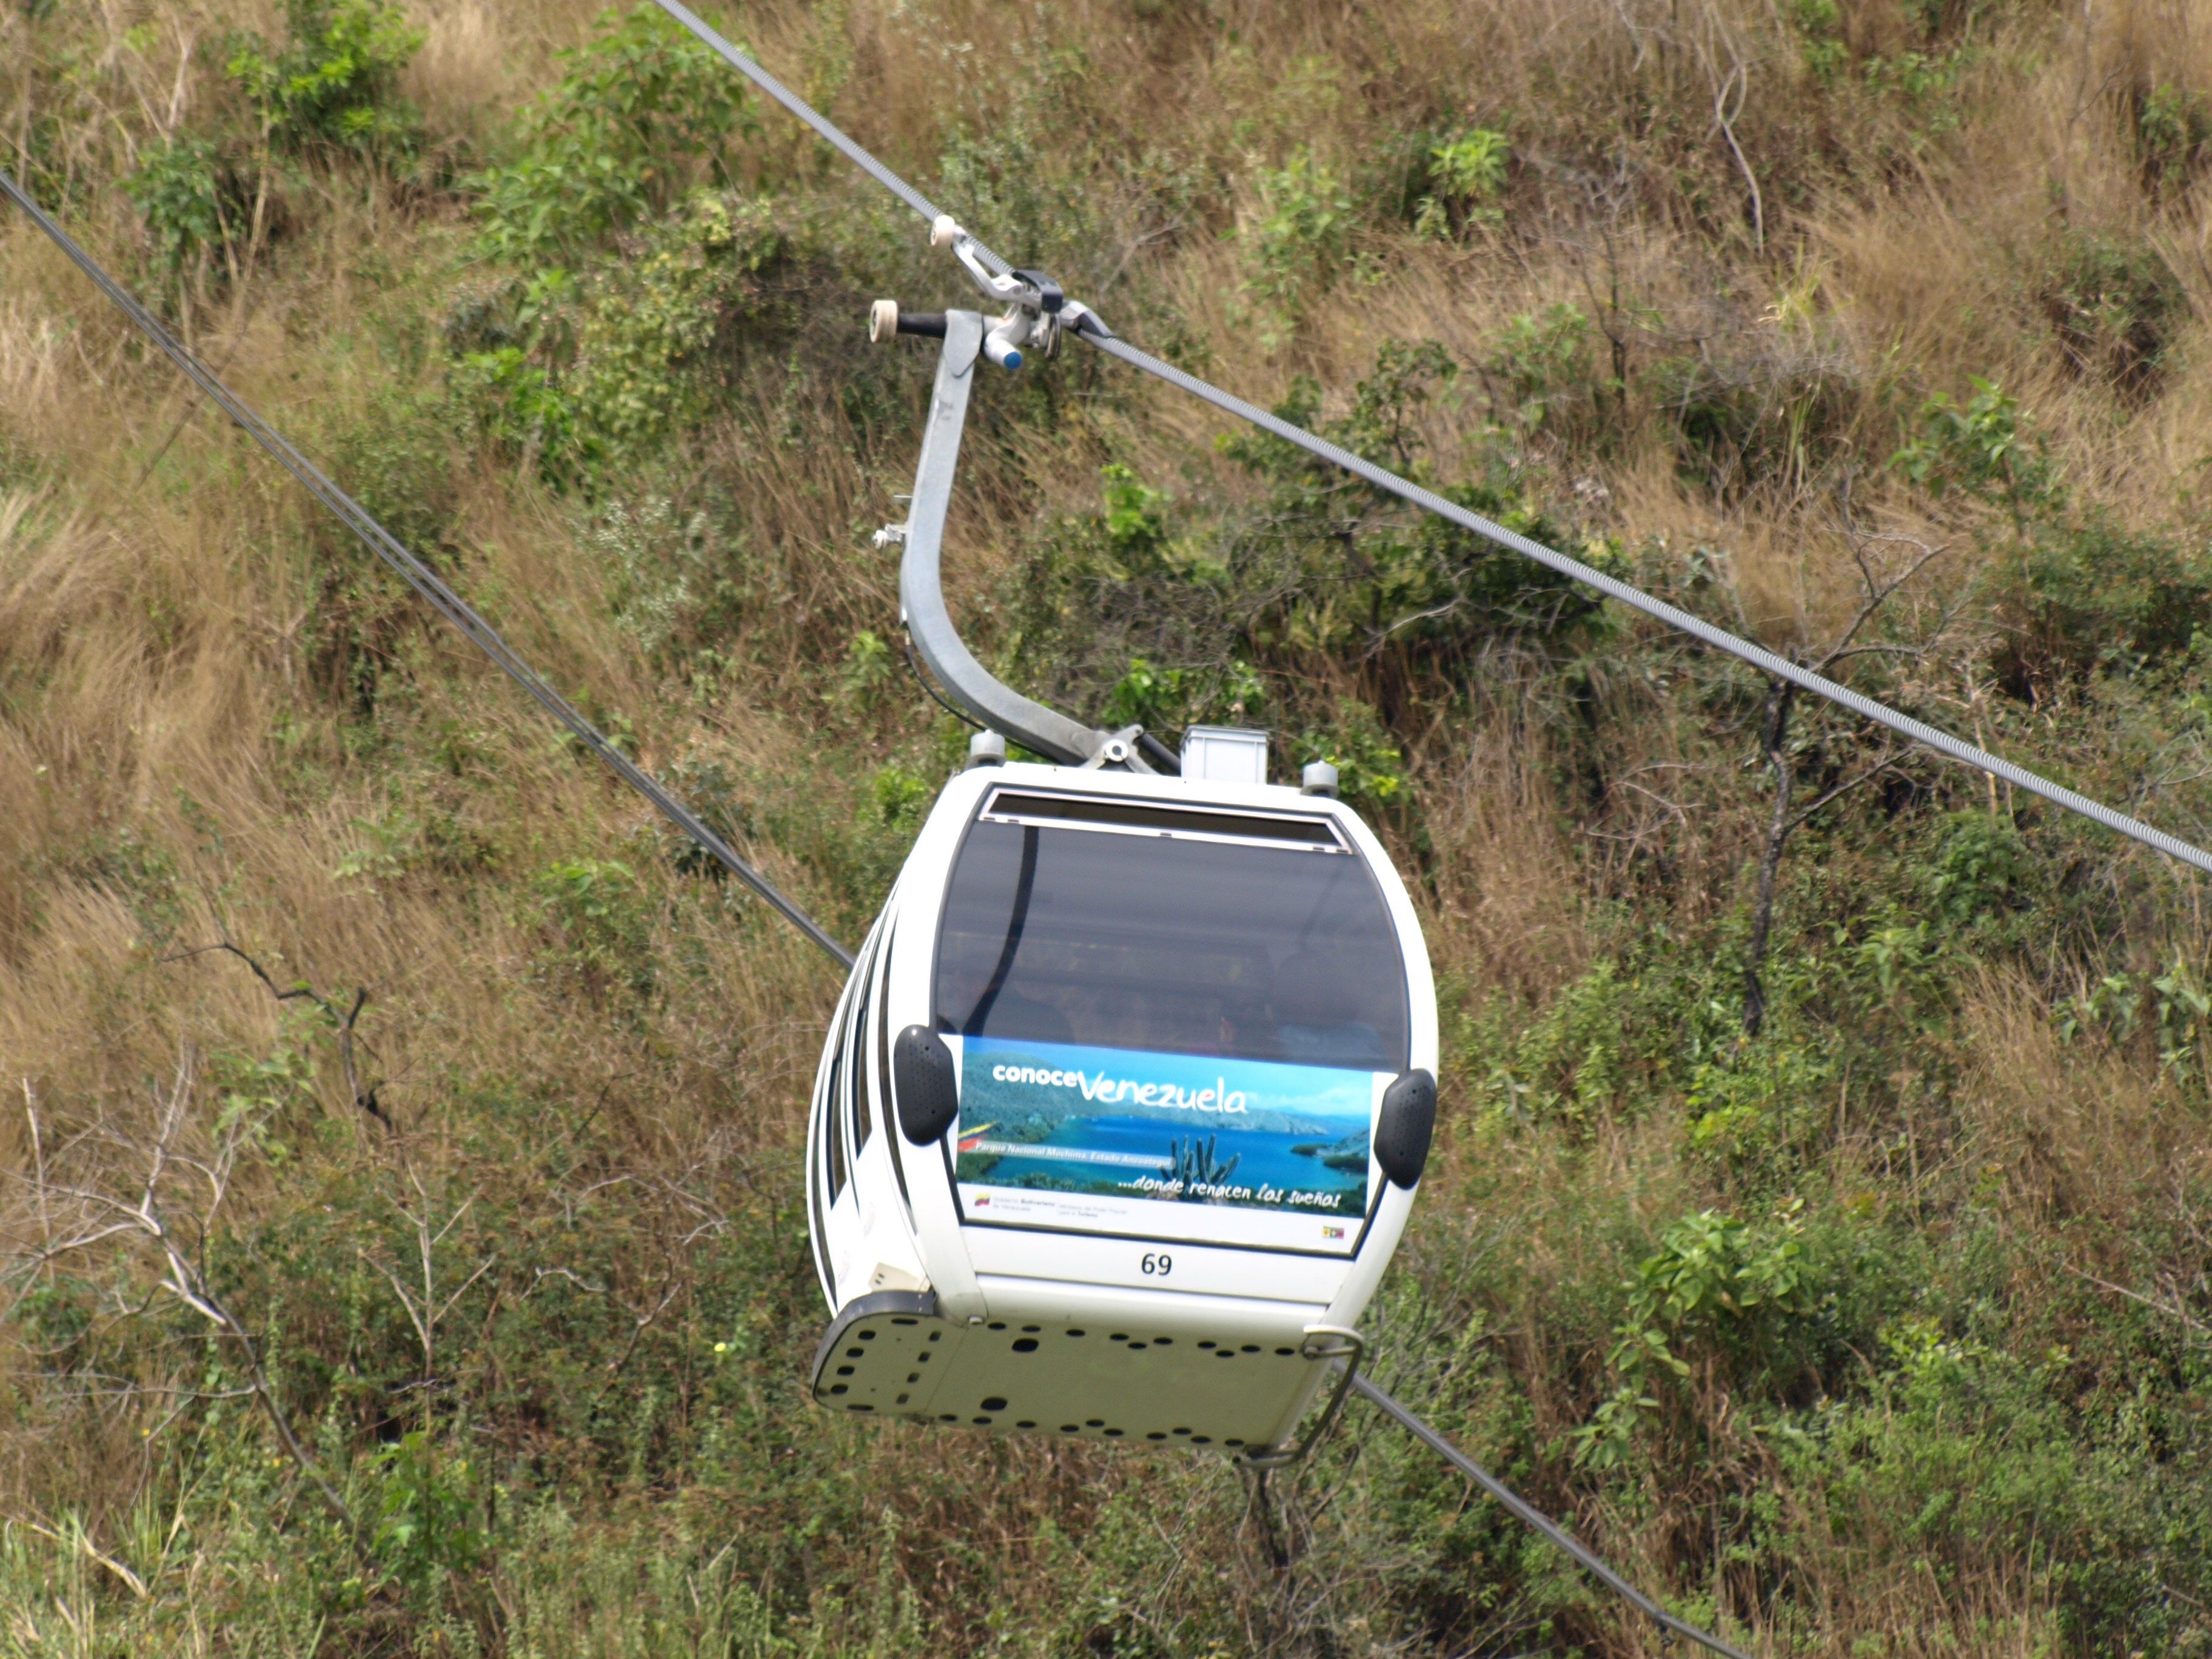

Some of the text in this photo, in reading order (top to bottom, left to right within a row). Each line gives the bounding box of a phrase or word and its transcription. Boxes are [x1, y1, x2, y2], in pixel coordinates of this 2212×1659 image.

[975, 1141, 1005, 1153] Parque
[1007, 1144, 1045, 1156] Nacional
[1090, 1151, 1120, 1163] Estado
[1188, 1182, 1252, 1201] renacen
[1256, 1183, 1284, 1204] los
[1286, 1190, 1342, 1208] sueños
[1141, 1252, 1173, 1276] 69
